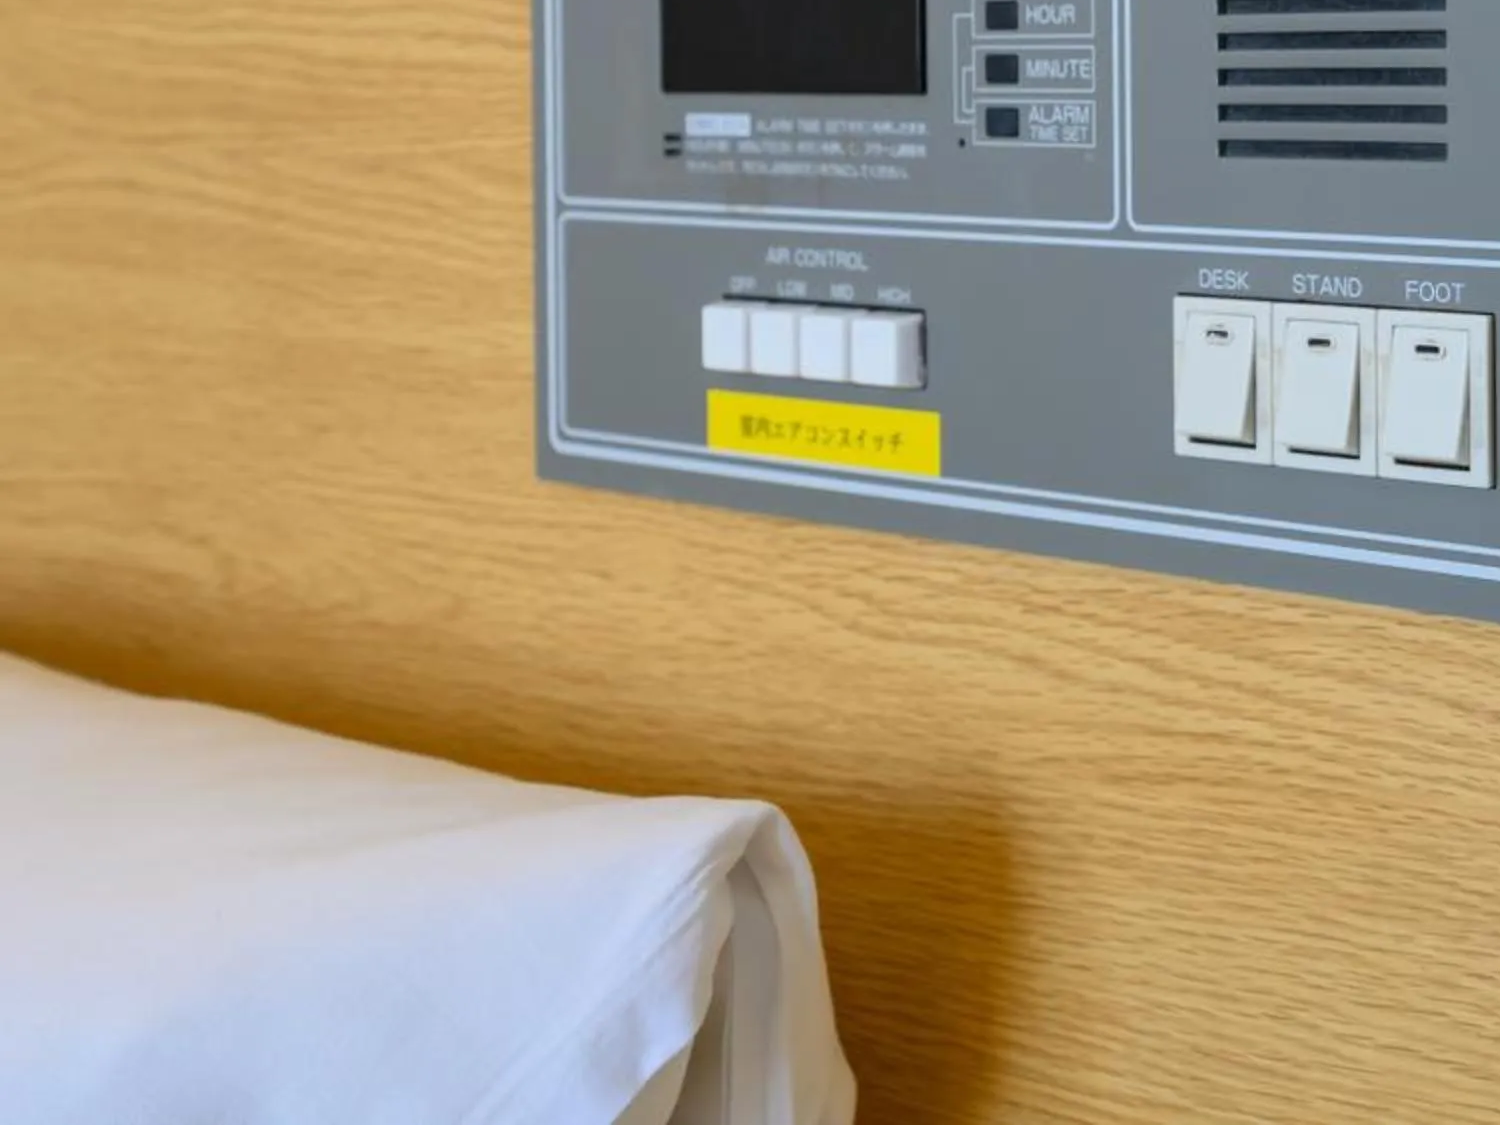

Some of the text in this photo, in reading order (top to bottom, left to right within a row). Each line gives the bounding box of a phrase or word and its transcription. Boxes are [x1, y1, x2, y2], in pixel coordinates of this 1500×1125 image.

[1025, 3, 1076, 25] HOUR
[1026, 59, 1091, 79] MINUTE
[1029, 104, 1090, 124] ALARM
[1030, 126, 1088, 142] TIME SET
[765, 246, 868, 271] AIR CONTROL
[1198, 268, 1250, 290] DESK
[1292, 273, 1363, 298] STAND
[1405, 280, 1466, 304] FOOT
